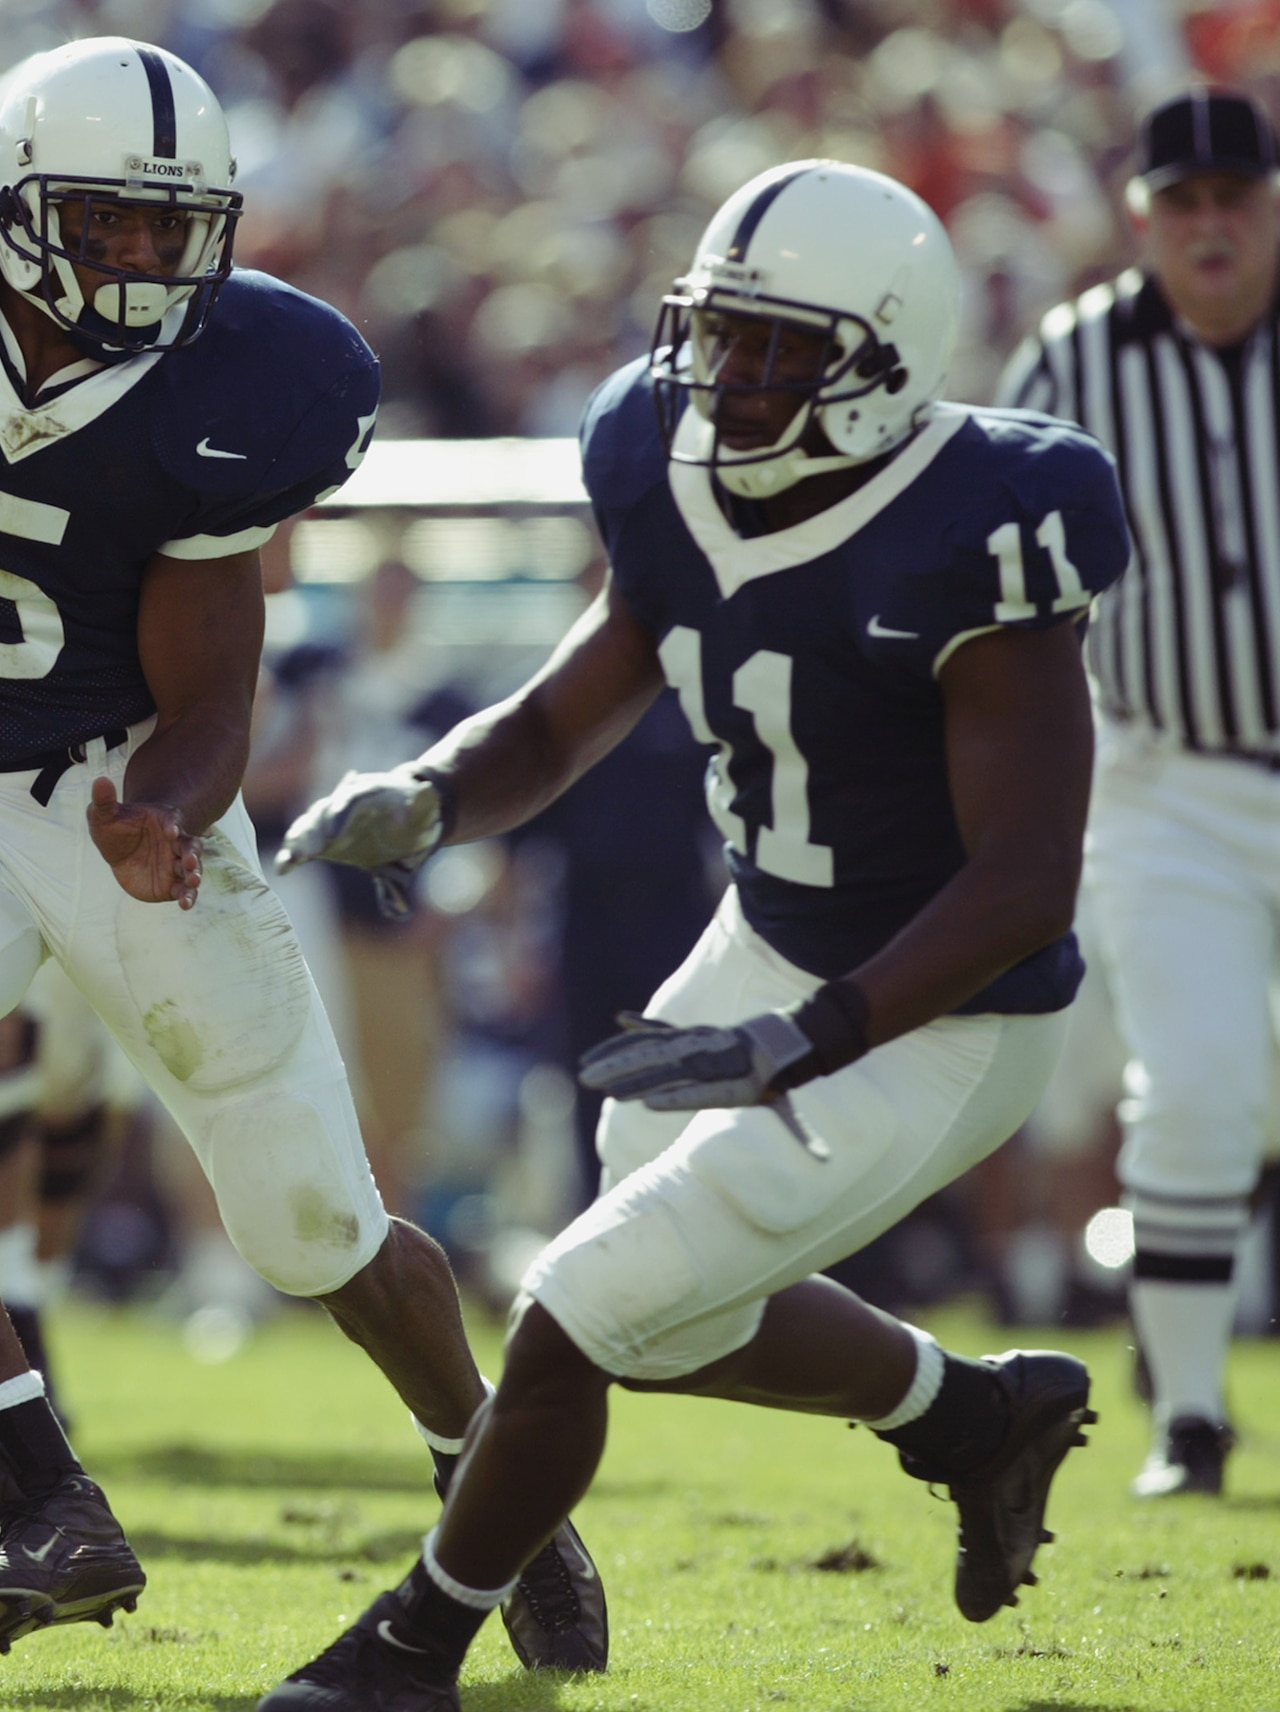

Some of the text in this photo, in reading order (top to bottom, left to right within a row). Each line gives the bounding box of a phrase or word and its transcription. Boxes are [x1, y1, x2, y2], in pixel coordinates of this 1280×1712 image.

[143, 162, 184, 177] LIONS
[986, 509, 1092, 622] 11
[657, 624, 834, 888] 11
